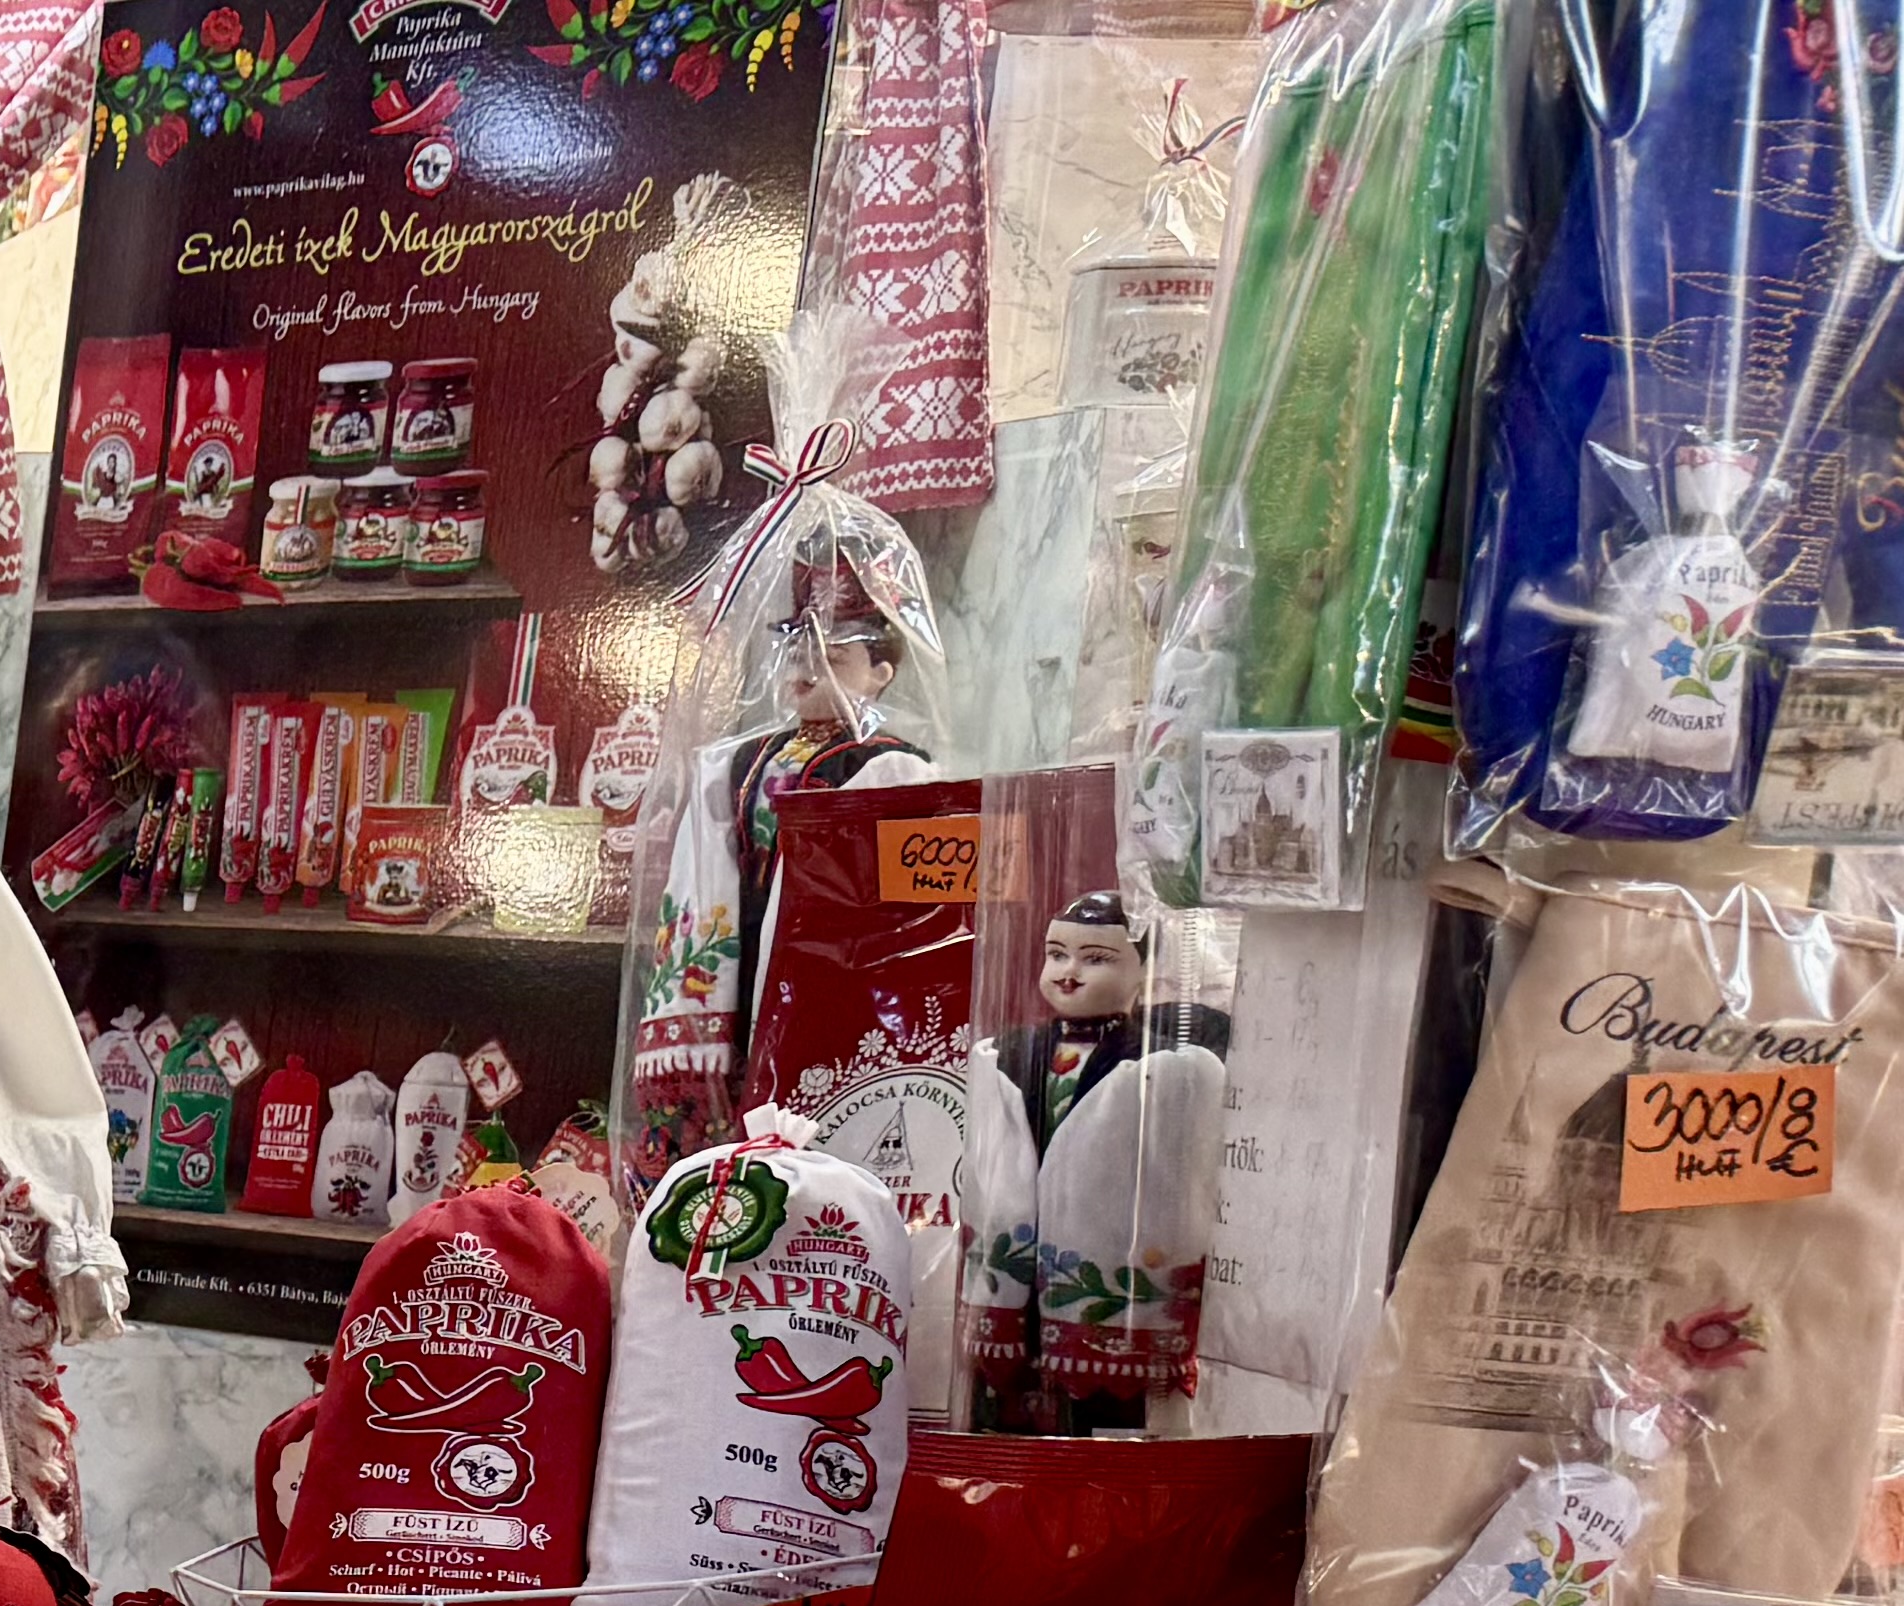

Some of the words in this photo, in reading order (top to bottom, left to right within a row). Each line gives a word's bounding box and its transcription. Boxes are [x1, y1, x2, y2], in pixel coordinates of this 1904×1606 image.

[395, 7, 461, 36] Paprika
[177, 219, 285, 276] Eredeti
[294, 208, 360, 275] ízek
[362, 176, 655, 277] Magyarországról
[1117, 278, 1214, 299] PAPRIK
[252, 301, 324, 341] Original
[323, 297, 393, 338] flavors
[391, 293, 447, 331] from
[451, 284, 541, 328] Hungary
[81, 407, 147, 446] PAPRIKA
[1646, 704, 1730, 732] HUNGARY
[472, 745, 553, 772] PAPRIKA
[1562, 970, 1864, 1068] Budapest
[263, 1103, 314, 1132] CHILI
[815, 1083, 897, 1146] KALOCSA
[1629, 1077, 1821, 1166] 3000/8
[793, 1240, 866, 1259] HUNGARY
[429, 1263, 504, 1282] HUNGARY
[769, 1257, 838, 1277] OSZTÁLYÚ
[136, 1267, 207, 1292] Chili-Trade
[246, 1282, 277, 1297] 6351
[405, 1282, 475, 1307] OSZTÁLYÚ
[343, 1301, 587, 1375] PAPRIKA
[788, 1312, 861, 1345] ŐRLEMÉNY
[420, 1337, 497, 1360] ŐRLEMÉNY
[724, 1443, 779, 1474] 500g
[358, 1462, 412, 1485] 500g
[396, 1544, 475, 1567] CSÍPŐS
[328, 1563, 374, 1579] Scharf
[388, 1564, 415, 1580] Hot
[428, 1565, 484, 1583] Picante
